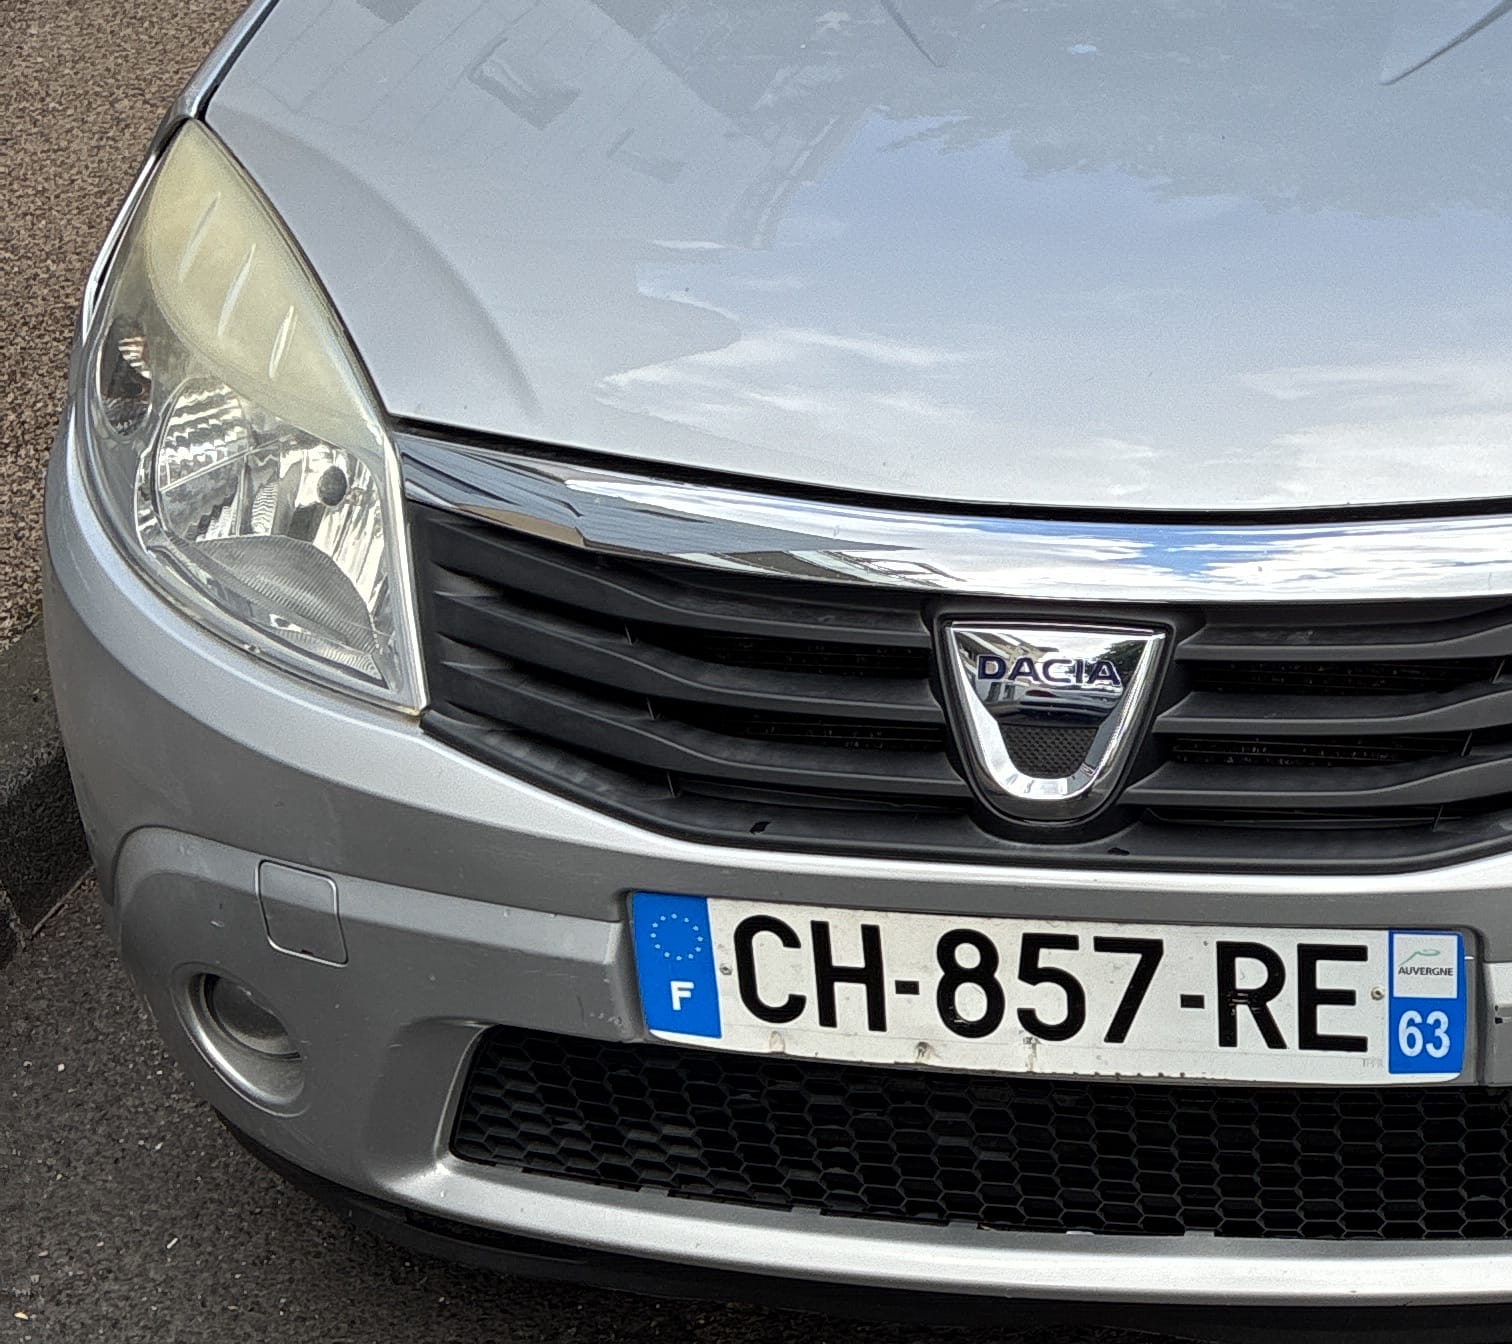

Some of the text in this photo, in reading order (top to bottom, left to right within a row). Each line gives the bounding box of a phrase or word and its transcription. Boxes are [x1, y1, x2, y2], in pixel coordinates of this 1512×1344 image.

[977, 655, 1121, 686] DACIA
[733, 914, 1369, 1053] CH-857-RE
[1397, 966, 1454, 977] AUVERGNE
[670, 980, 695, 1011] F
[1398, 1010, 1451, 1058] 63
